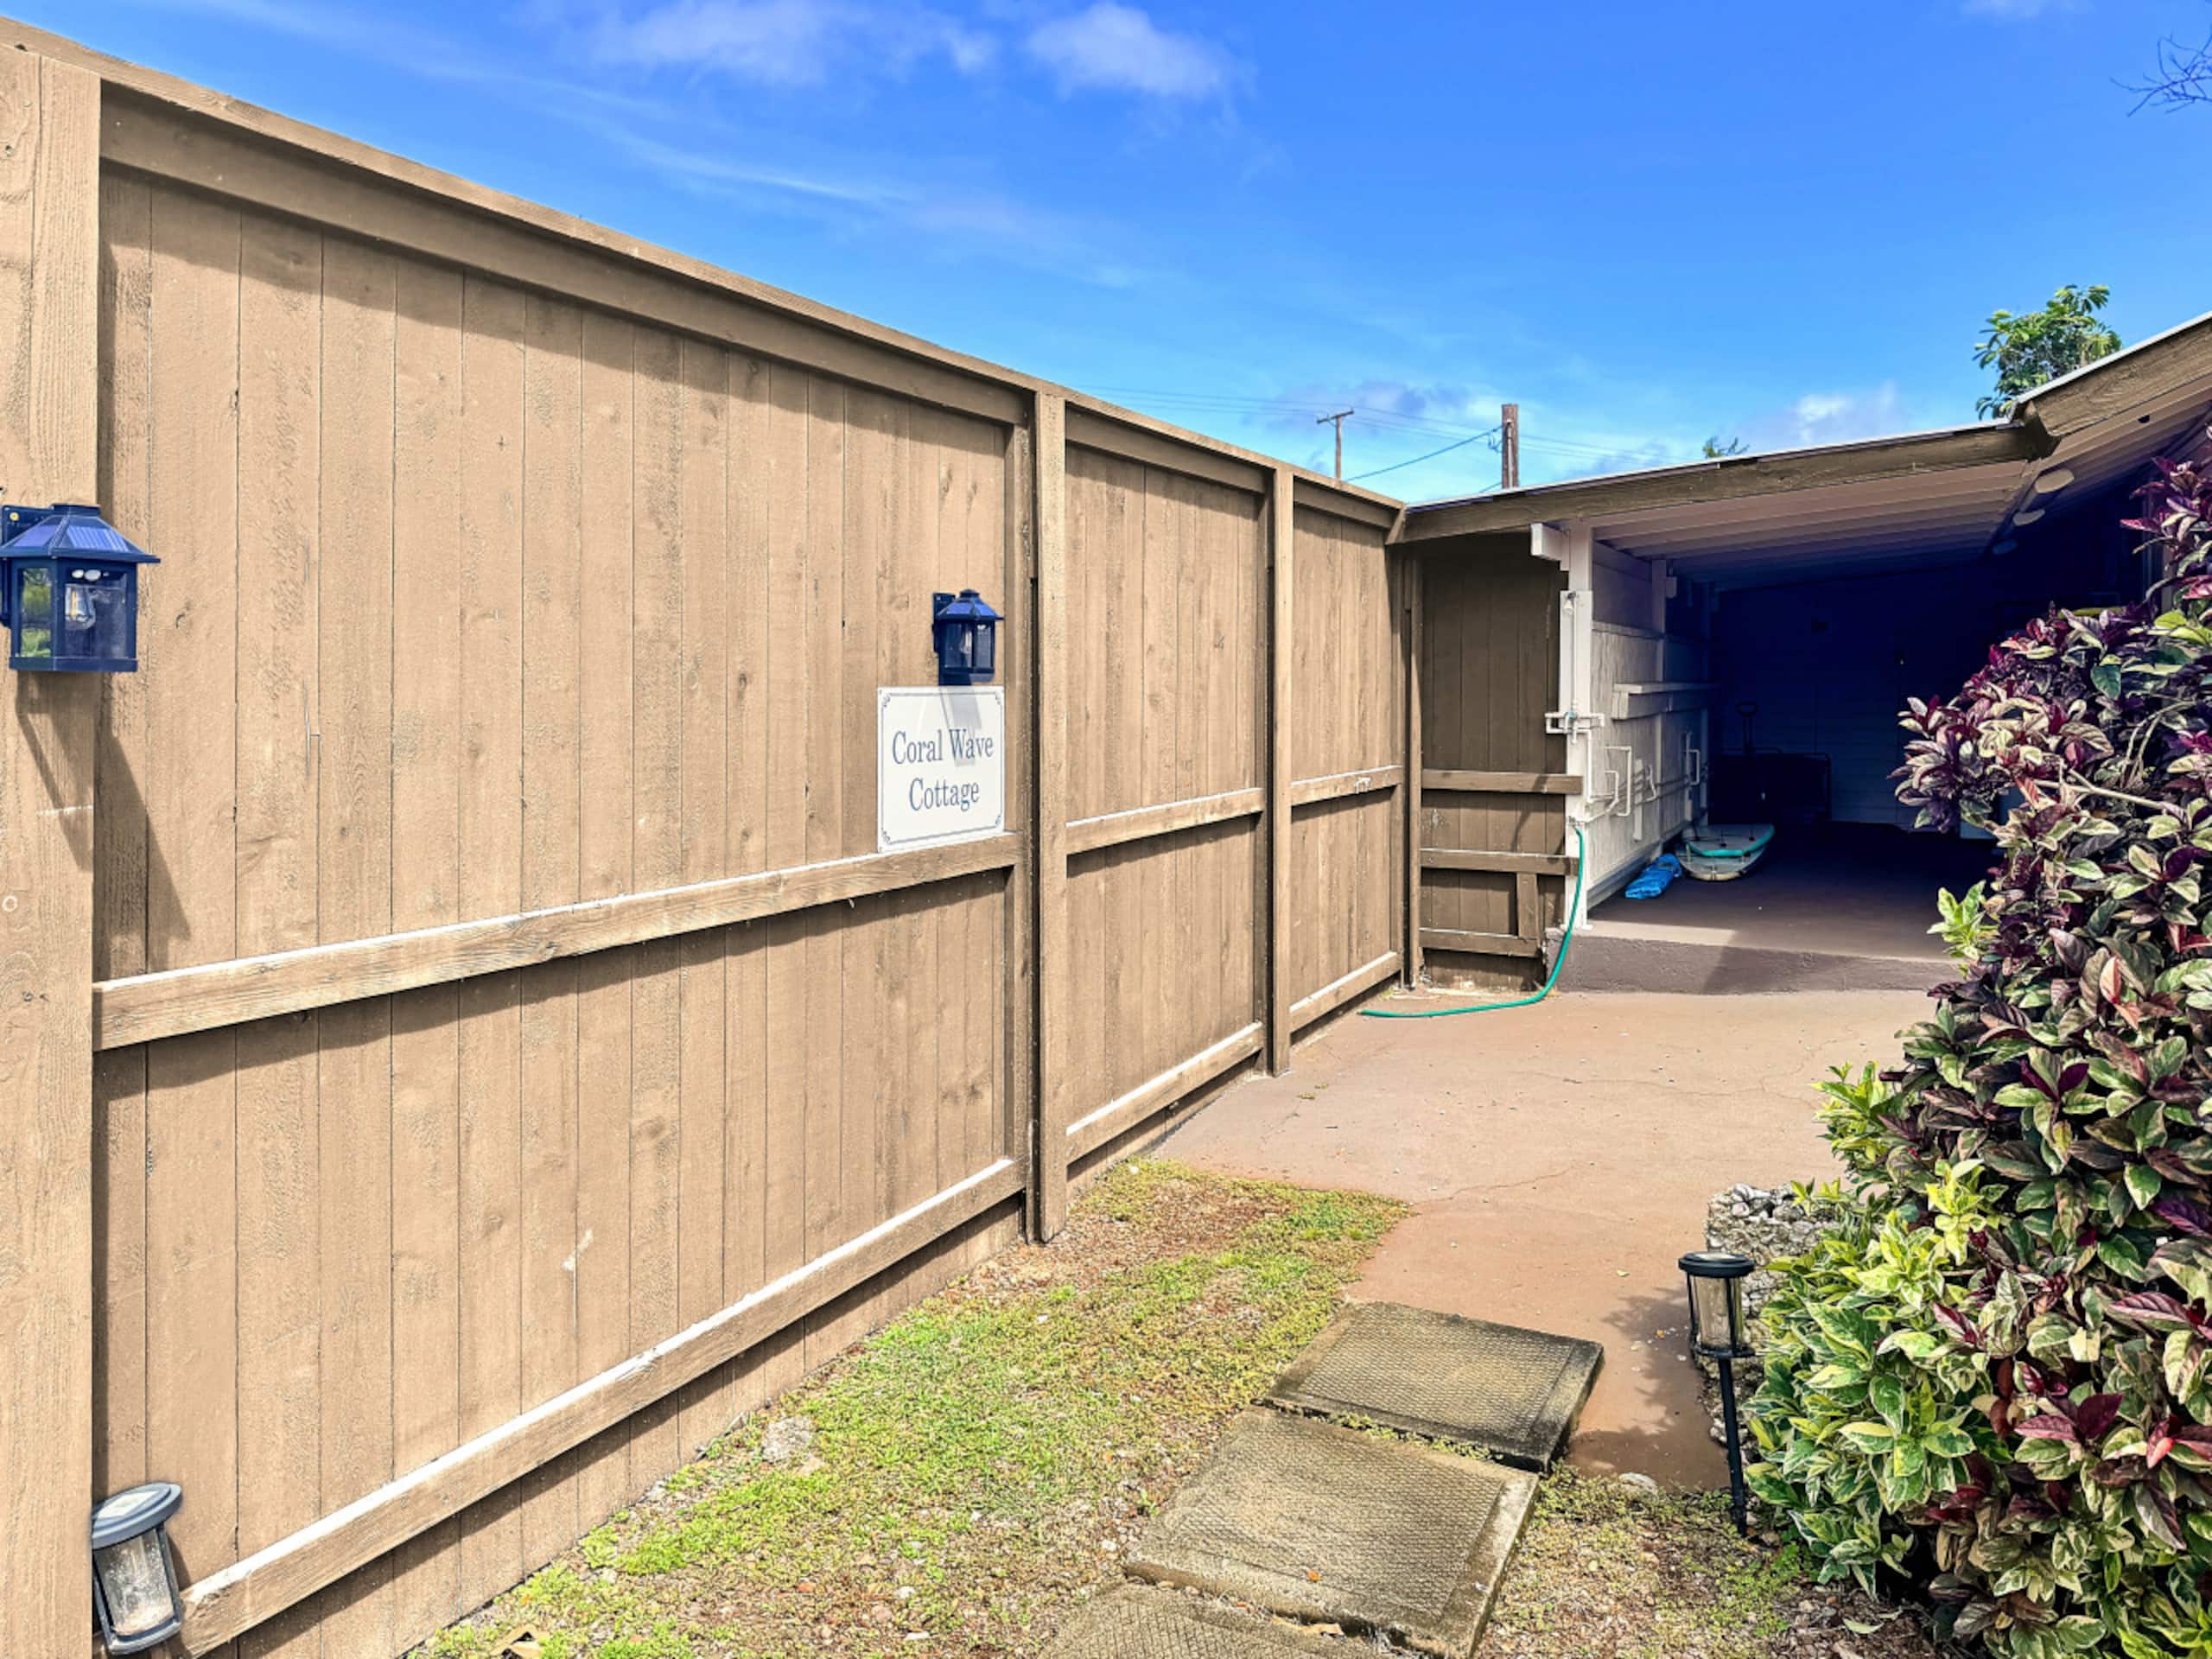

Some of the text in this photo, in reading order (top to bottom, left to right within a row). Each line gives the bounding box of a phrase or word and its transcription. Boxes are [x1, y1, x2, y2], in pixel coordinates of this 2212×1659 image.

[893, 728, 994, 764] Coral Wave
[909, 778, 980, 811] Cottage
